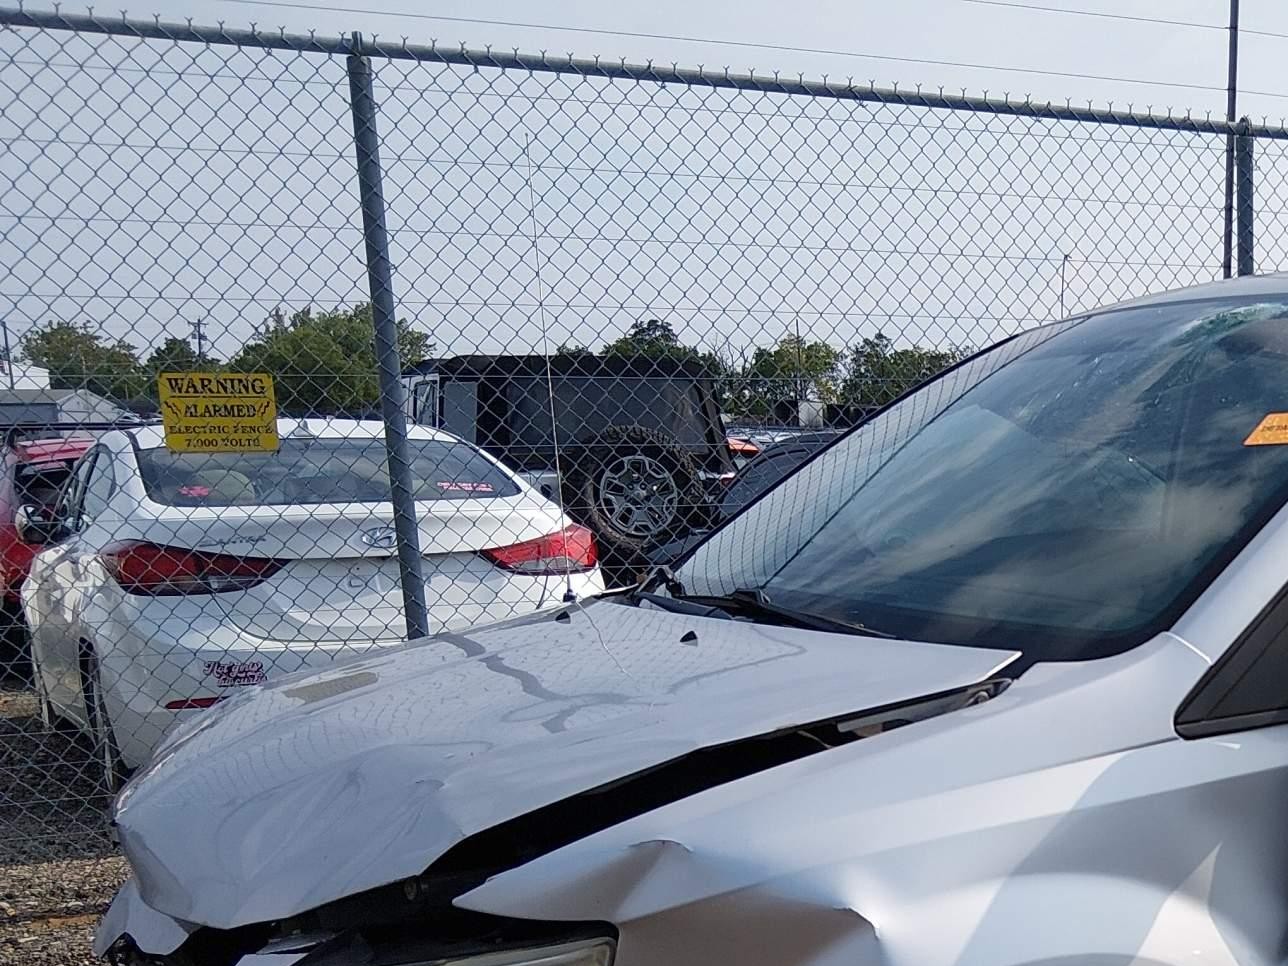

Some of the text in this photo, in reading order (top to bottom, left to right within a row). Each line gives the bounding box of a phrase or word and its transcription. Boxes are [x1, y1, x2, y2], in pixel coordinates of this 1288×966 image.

[166, 377, 266, 395] WARNING
[183, 403, 257, 418] ALARMED
[168, 424, 274, 435] ELECTRIC FENCE
[221, 438, 261, 448] VOLTS
